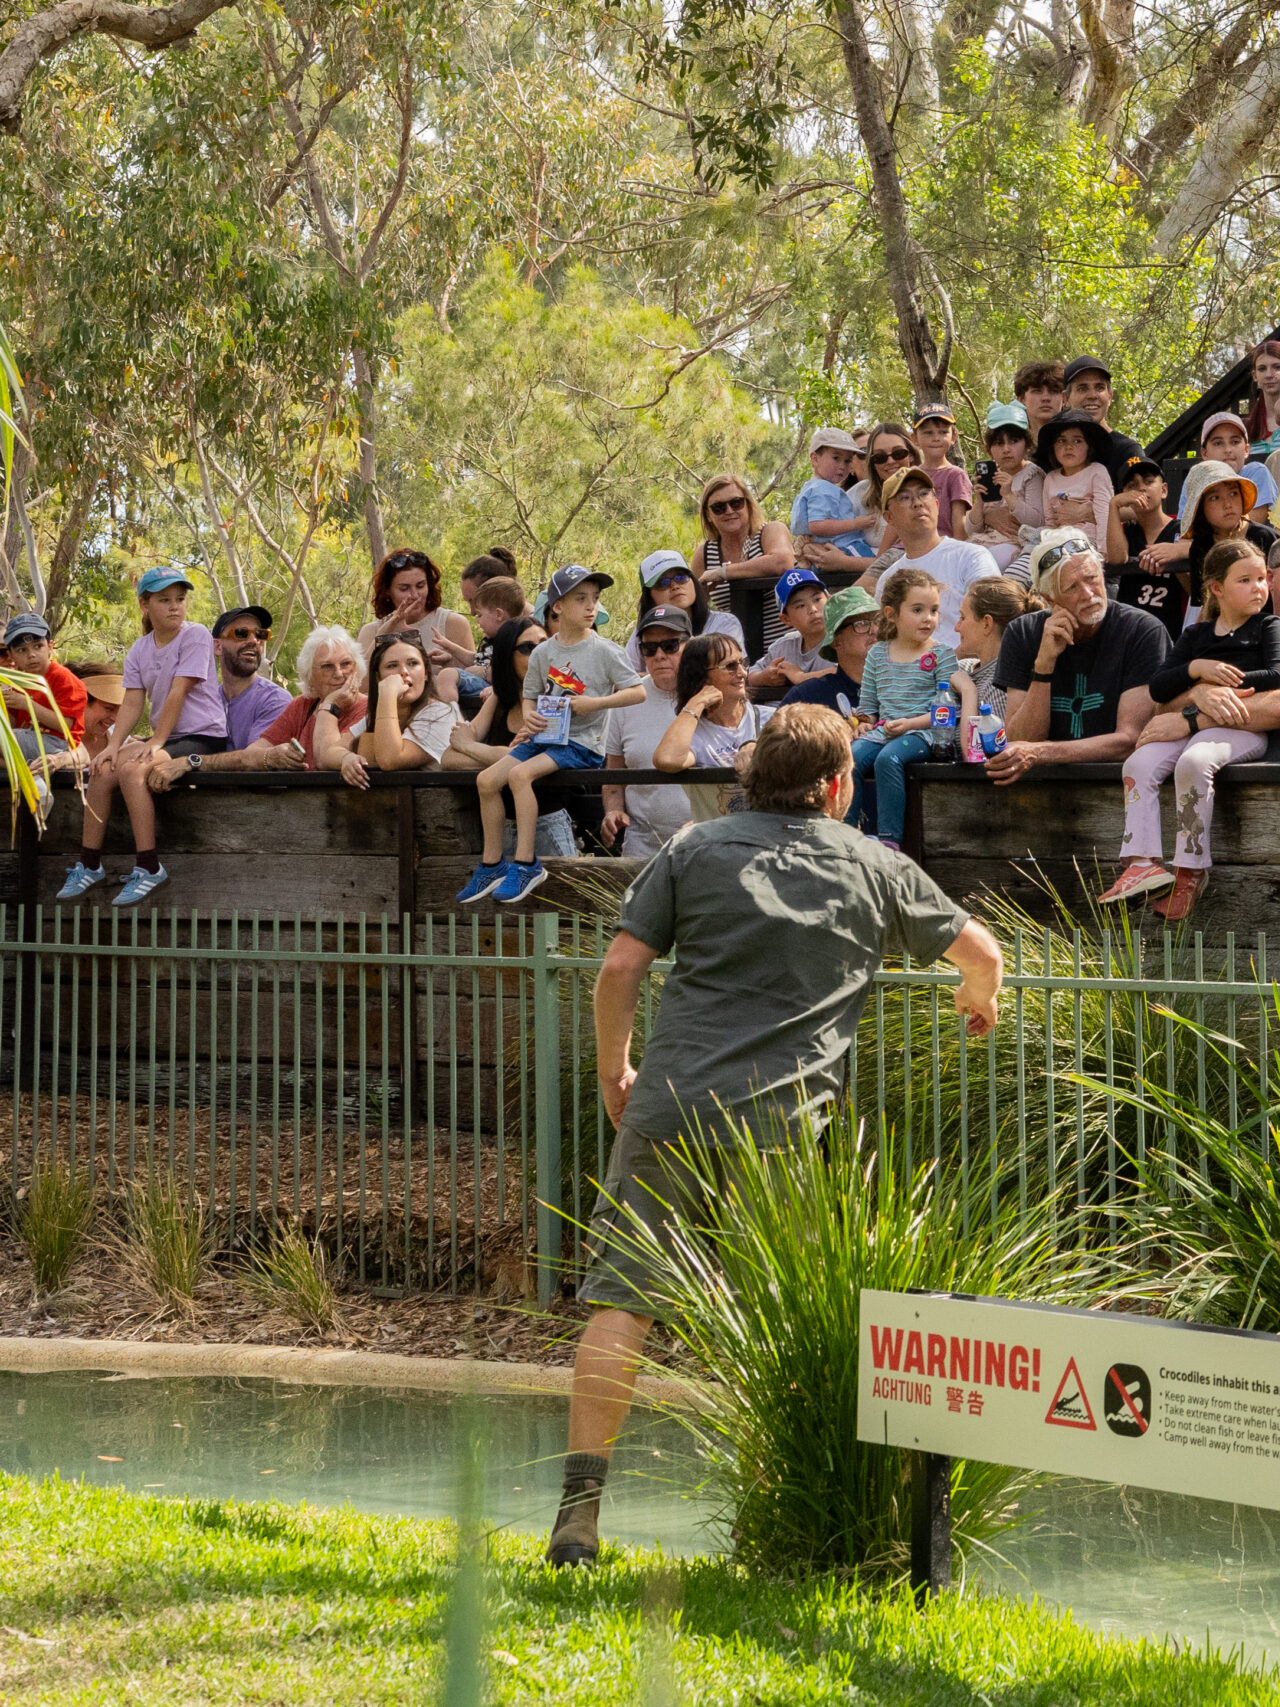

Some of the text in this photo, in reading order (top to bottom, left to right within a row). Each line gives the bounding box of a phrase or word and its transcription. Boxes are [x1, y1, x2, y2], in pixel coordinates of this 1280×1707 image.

[1137, 584, 1168, 607] 32
[869, 1324, 1041, 1393] WARNING!
[872, 1376, 932, 1406] ACHTUNG
[1159, 1367, 1211, 1386] Crocodiles
[1213, 1374, 1250, 1391] inhabit
[1251, 1379, 1271, 1394] this
[945, 1386, 985, 1416] 警告
[1164, 1390, 1185, 1403] Keep
[1187, 1395, 1209, 1409] away
[1211, 1396, 1232, 1410] from
[1234, 1401, 1248, 1412] the
[1250, 1404, 1280, 1417] water's
[1164, 1403, 1185, 1416] Take
[1186, 1408, 1221, 1422] extreme
[1223, 1414, 1242, 1425] care
[1244, 1417, 1267, 1429] when
[1164, 1417, 1176, 1429] Do
[1178, 1419, 1192, 1431] not
[1194, 1422, 1216, 1434] clean
[1218, 1425, 1234, 1438] fish
[1236, 1429, 1245, 1439] or
[1247, 1430, 1270, 1443] leave
[1164, 1431, 1189, 1446] Camp
[1190, 1435, 1207, 1447] well
[1208, 1439, 1231, 1454] away
[1233, 1441, 1254, 1454] from
[1256, 1445, 1271, 1458] the
